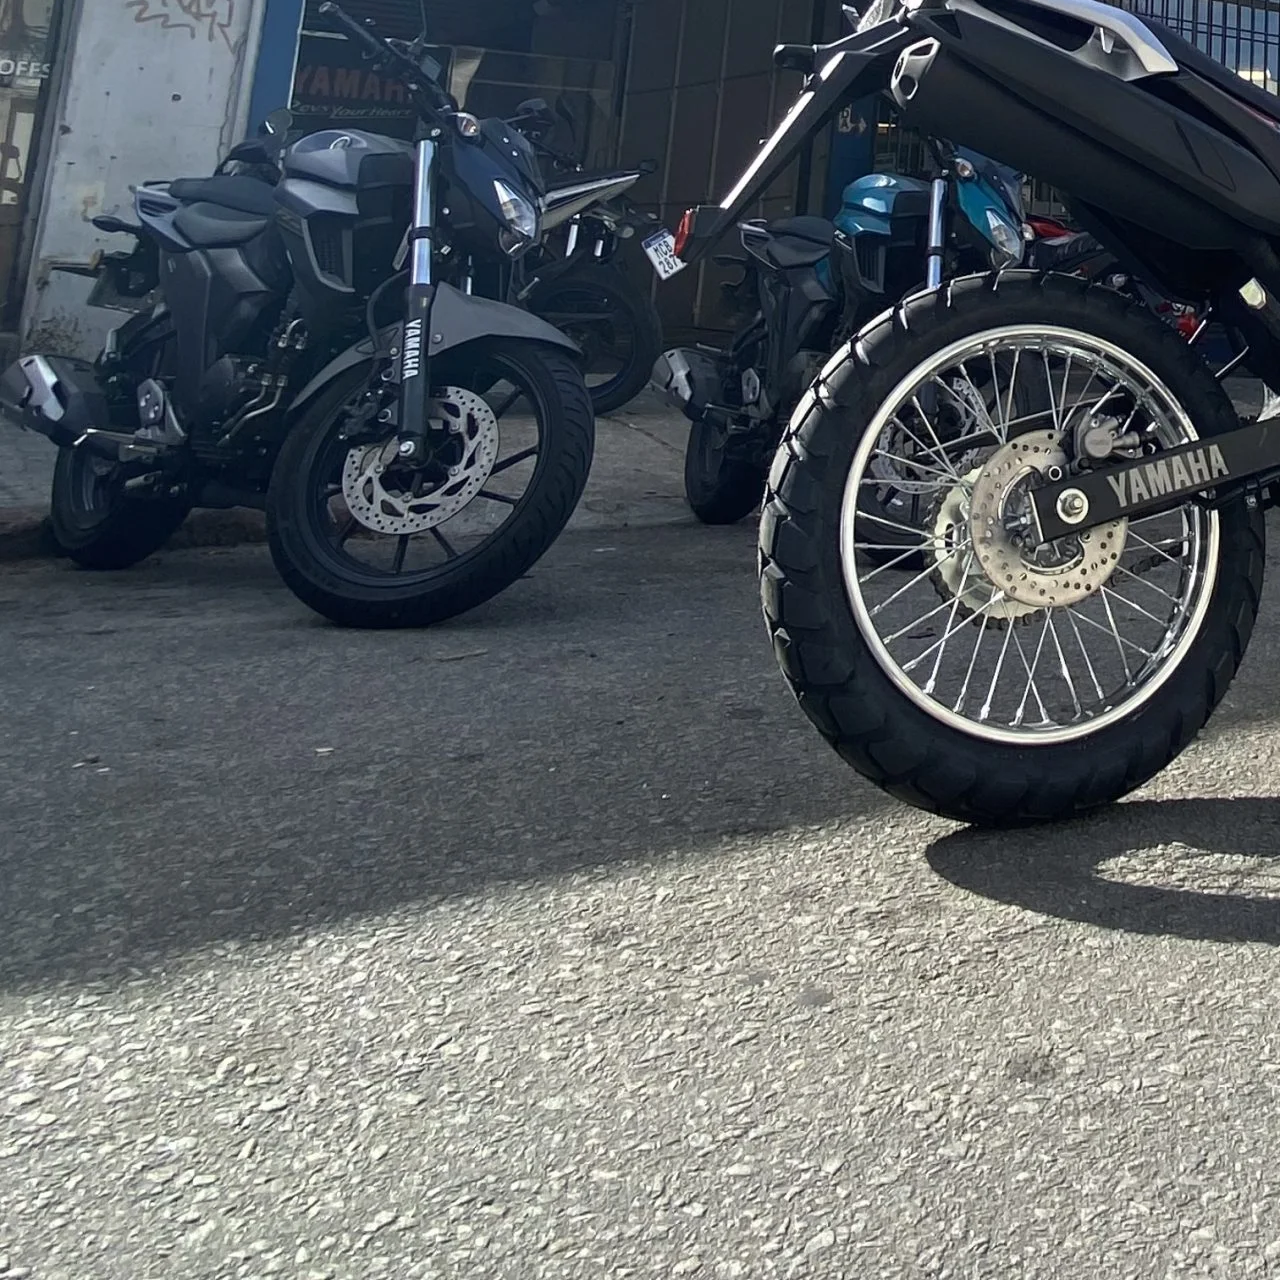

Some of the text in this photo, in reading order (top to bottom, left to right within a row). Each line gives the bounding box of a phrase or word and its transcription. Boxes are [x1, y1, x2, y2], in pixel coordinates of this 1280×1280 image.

[295, 64, 414, 104] YAMAH
[403, 319, 421, 380] YAMAHA
[1107, 444, 1229, 508] YAMAHA
